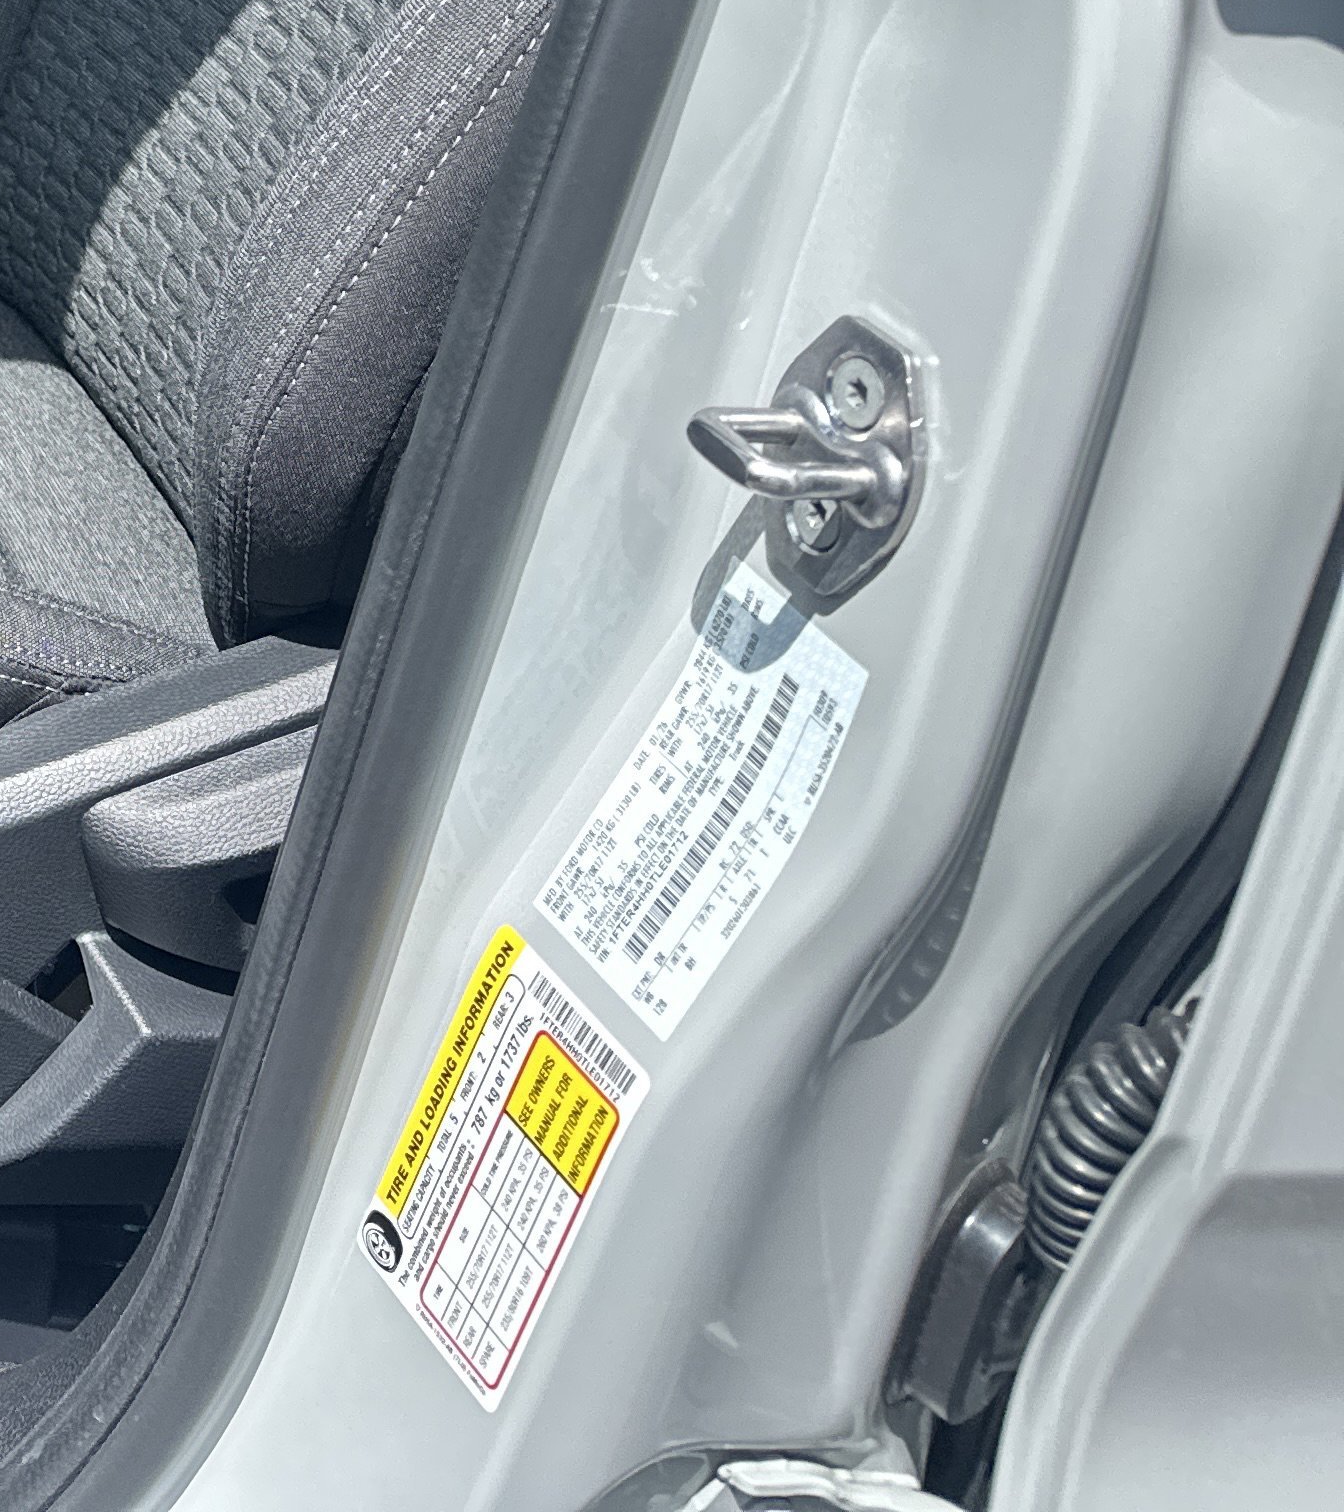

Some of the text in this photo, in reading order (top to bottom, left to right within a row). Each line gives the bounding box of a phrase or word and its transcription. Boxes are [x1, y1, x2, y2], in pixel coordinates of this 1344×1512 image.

[658, 728, 674, 750] REAR
[695, 666, 711, 688] 1619
[705, 653, 716, 667] KG
[682, 759, 693, 773] AT
[696, 731, 711, 750] 240
[727, 680, 738, 695] 35
[739, 653, 750, 669] PSI
[745, 632, 759, 655] COLD
[702, 634, 713, 650] KG
[667, 736, 683, 758] WITH
[709, 663, 724, 684] 112T
[727, 737, 745, 761] Truck
[557, 900, 574, 922] WITH
[601, 836, 617, 858] 112T
[648, 762, 666, 785] TIRES
[580, 703, 737, 947] THIS VEHICLE CONFORMS TO ALL APPLICABLE FEDERAL MOTOR VEHICLE
[588, 927, 609, 956] SAFETY
[605, 885, 638, 930] STANDARDS
[633, 876, 644, 888] IN
[640, 852, 660, 879] EFFECT
[656, 839, 669, 854] ON
[664, 824, 678, 841] THE
[674, 805, 691, 826] DATE
[686, 794, 698, 808] OF
[694, 740, 730, 797] MANUFACTURE
[725, 711, 745, 743] SHOWN
[658, 772, 675, 794] RIMS
[549, 888, 569, 913] FRONT
[591, 830, 608, 852] 1420
[604, 819, 615, 833] KG
[555, 875, 565, 888] BY
[562, 854, 579, 877] FORD
[575, 829, 596, 857] MOTOR
[572, 925, 583, 939] AT
[583, 905, 597, 923] 240
[617, 859, 628, 873] 35
[633, 832, 646, 848] PSI
[642, 812, 659, 835] COLD
[677, 941, 687, 953] TR
[731, 854, 747, 876] AXLE
[748, 836, 758, 849] TR
[652, 997, 668, 1016] 128
[385, 939, 514, 1207] TIRE AND LOADING INFORMATION
[401, 1198, 419, 1234] SEATING
[414, 1161, 435, 1203] CAPACITY
[449, 1111, 459, 1126] 5
[476, 1050, 486, 1064] 2
[504, 989, 515, 1004] 3
[470, 1008, 534, 1136] 787 kg or 1737 lbs.
[517, 1053, 555, 1128] SEE OWNERS
[533, 1070, 572, 1146] MANUAL FOR
[551, 1090, 588, 1163] ADDITIONAL
[567, 1103, 609, 1185] INFORMATION
[398, 1140, 468, 1288] The combined weight of occupants
[412, 1149, 475, 1283] and cargo should never exceed
[432, 1127, 513, 1301] TIRE SIZE COLD TIRE PRESSURE
[447, 1299, 463, 1330] FRONT
[465, 1243, 490, 1291] 255/70R17
[484, 1223, 498, 1249] 112T
[501, 1192, 513, 1213] 240
[517, 1160, 527, 1176] 35
[522, 1146, 533, 1164] PSI
[462, 1324, 476, 1350] REAR
[481, 1262, 506, 1310] 255/70R17
[500, 1242, 515, 1268] 112T
[517, 1211, 529, 1232] 240
[533, 1178, 543, 1195] 35
[538, 1165, 550, 1183] PSI
[479, 1339, 494, 1371] SPARE
[536, 1232, 548, 1254] 260
[552, 1199, 562, 1216] 38
[557, 1186, 568, 1204] PSI
